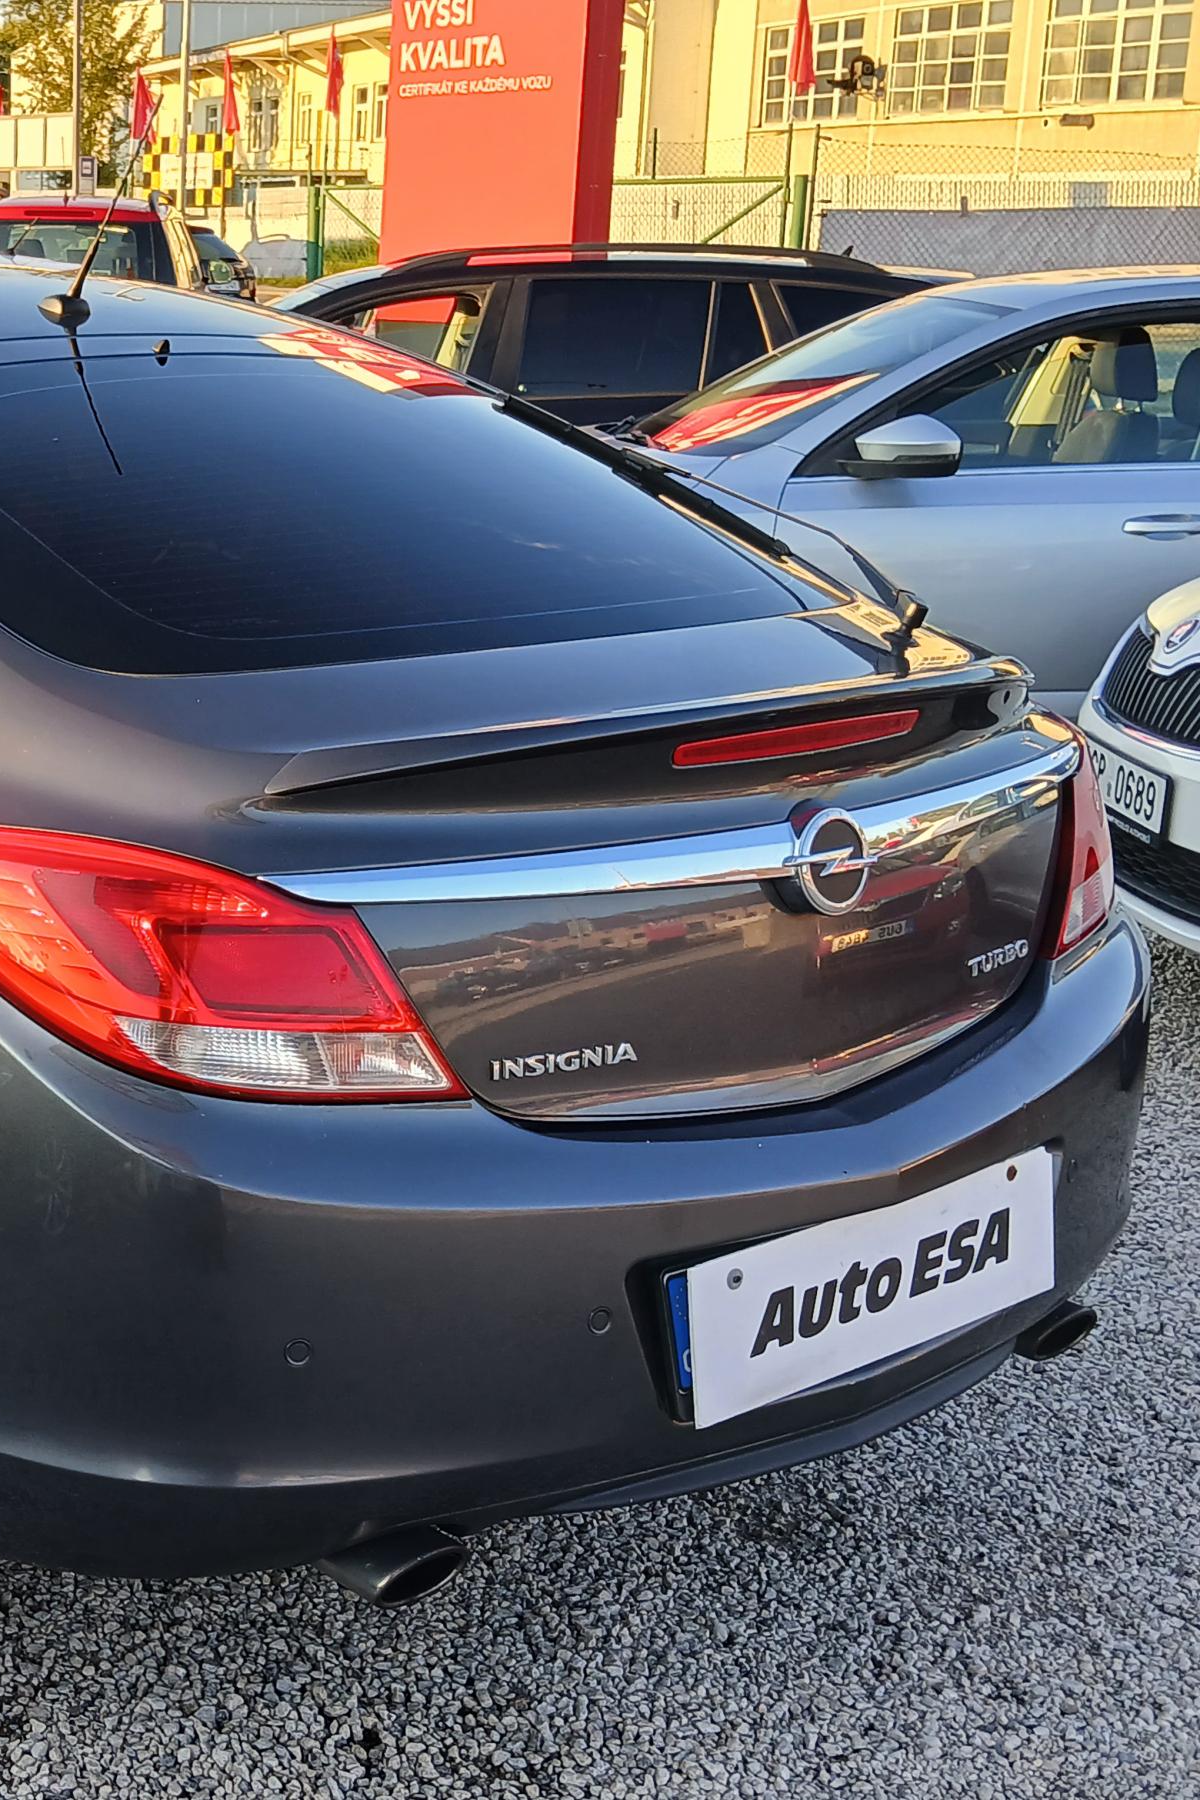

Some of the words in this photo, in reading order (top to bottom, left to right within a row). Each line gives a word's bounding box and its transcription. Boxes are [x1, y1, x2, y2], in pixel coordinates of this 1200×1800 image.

[400, 34, 506, 72] KVALITA
[399, 80, 454, 97] CERTIFIKÁT
[454, 80, 468, 95] KE
[521, 75, 552, 91] VOZU
[1115, 765, 1156, 822] 0689
[967, 939, 1030, 977] TURBO
[489, 1042, 638, 1082] INSIGNIA
[750, 1256, 902, 1359] Auto
[909, 1208, 1011, 1299] ESA
